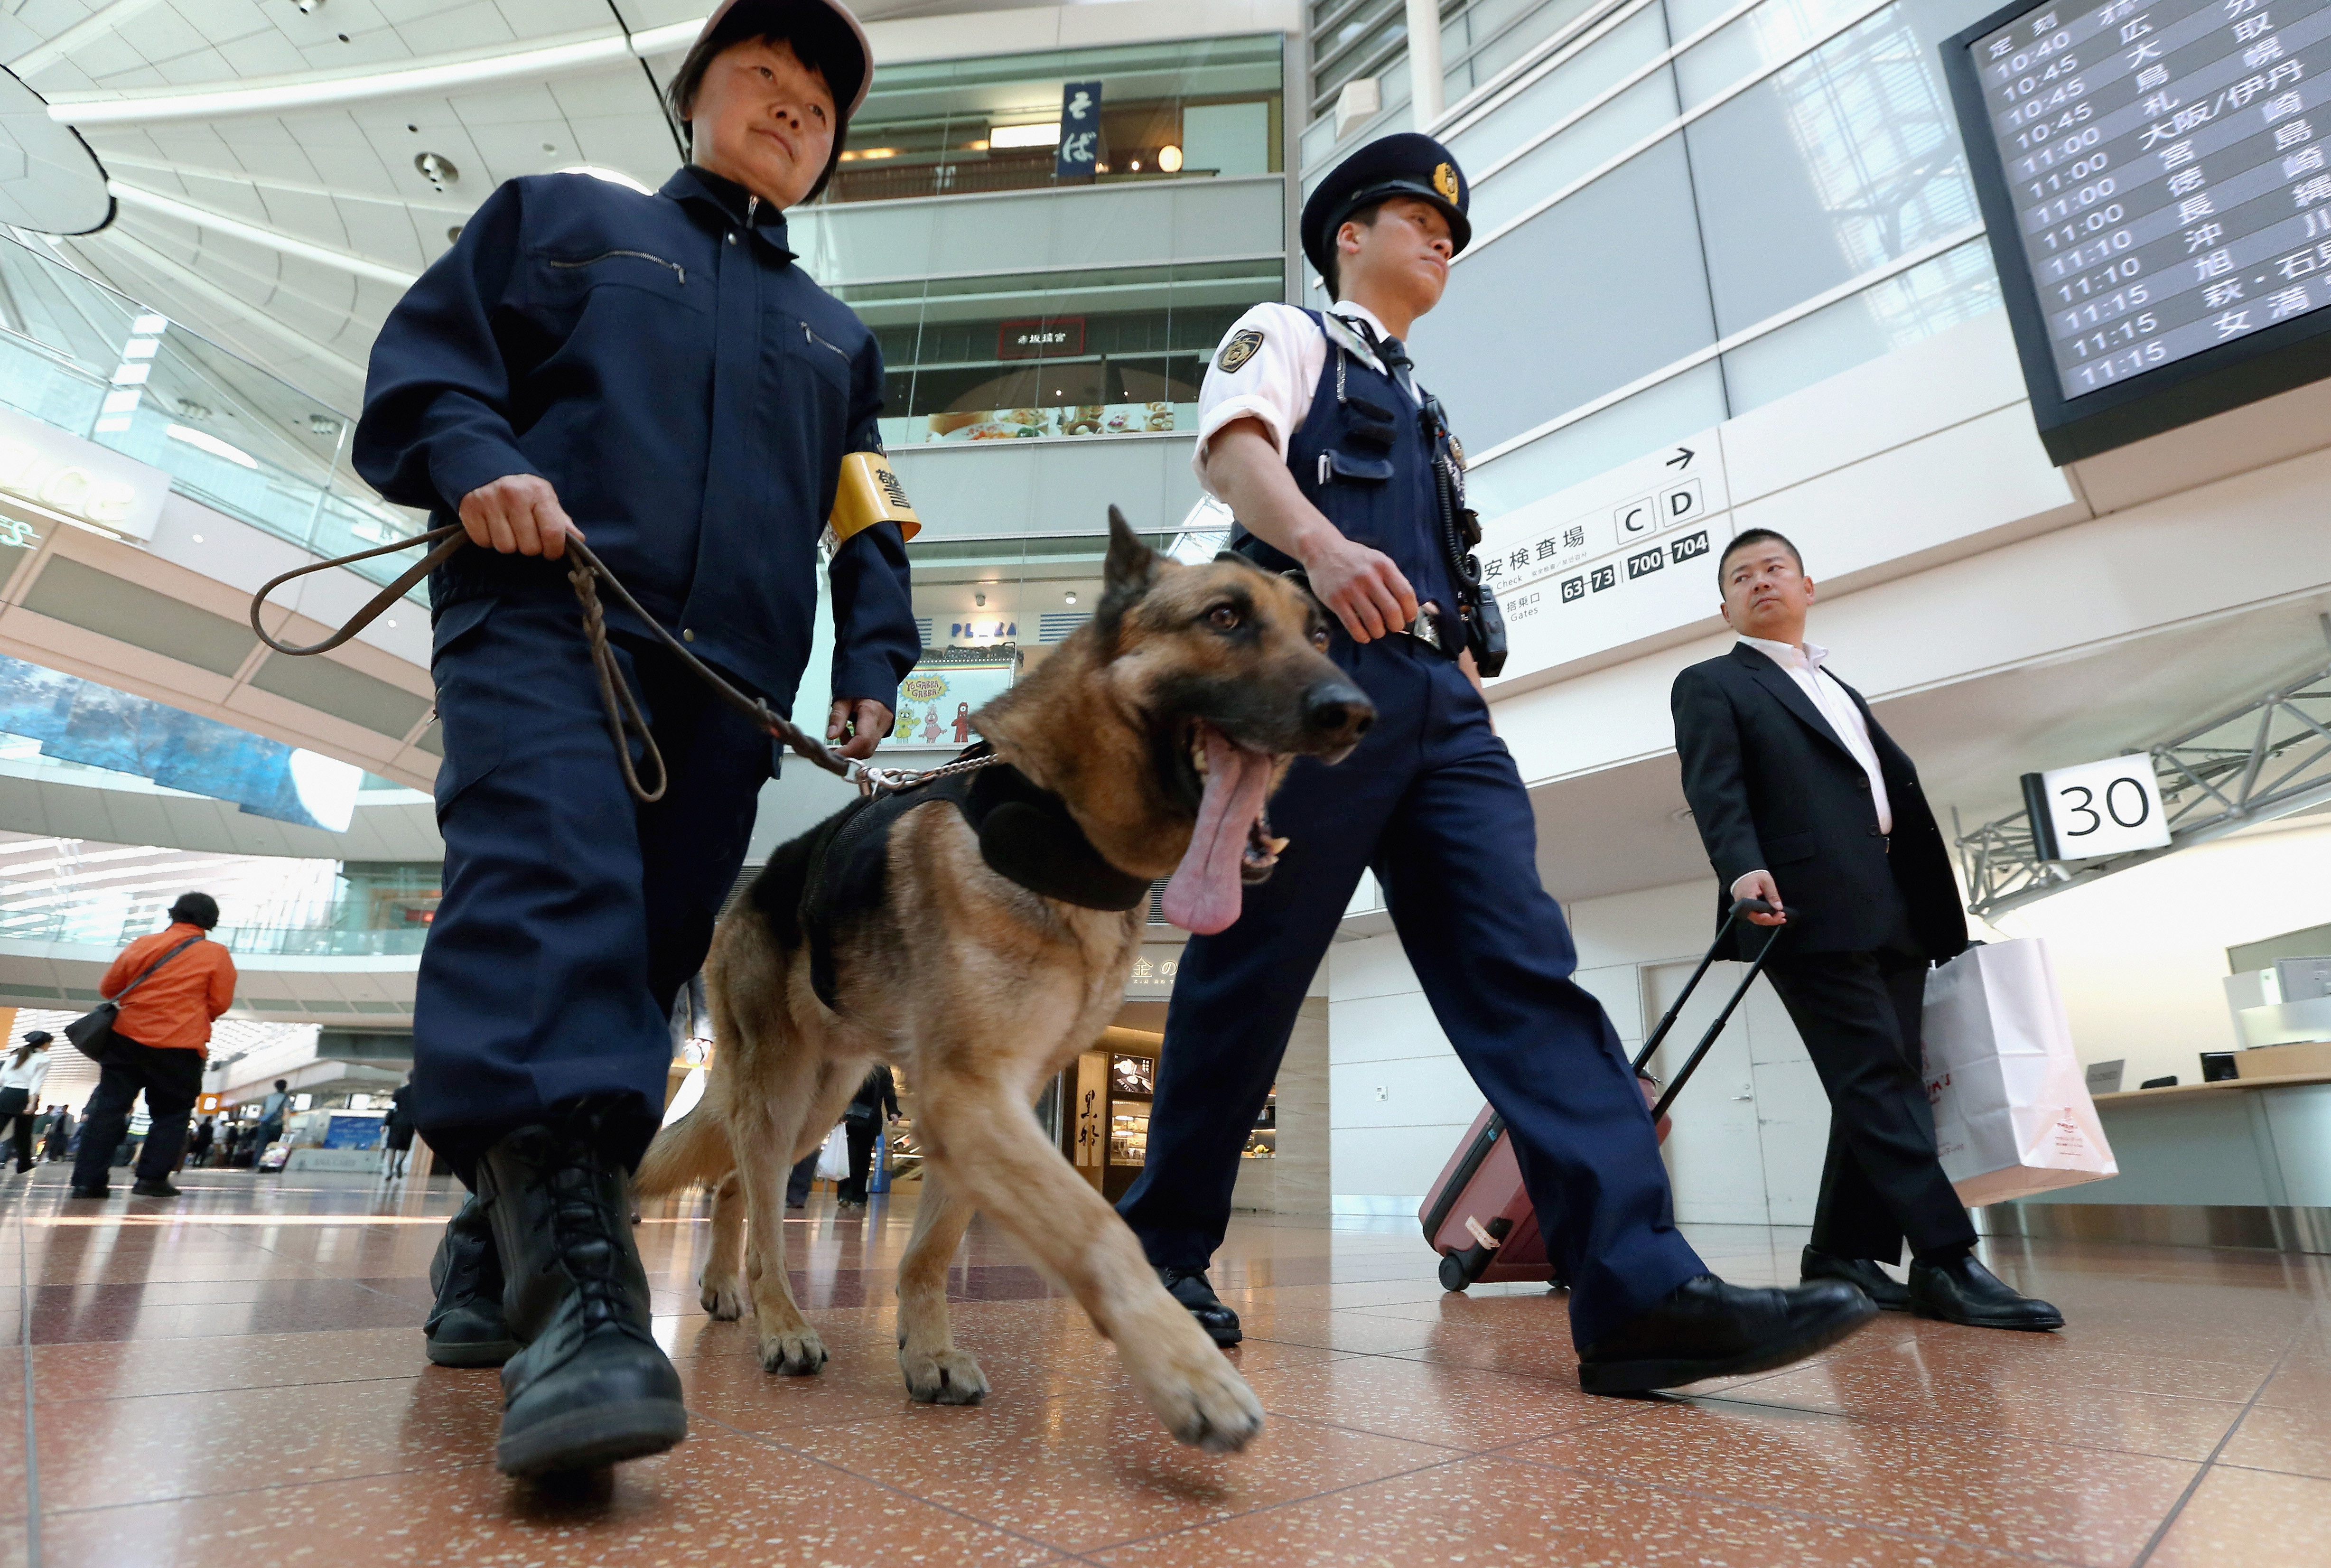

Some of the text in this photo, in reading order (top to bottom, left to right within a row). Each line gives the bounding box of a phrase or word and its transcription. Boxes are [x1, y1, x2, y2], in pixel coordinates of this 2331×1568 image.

[1997, 31, 2070, 78] 10:40
[2004, 54, 2077, 101] 10:45
[2010, 77, 2085, 125] 10:45
[1063, 91, 1097, 162] そば
[2016, 102, 2093, 149] 10:45
[2023, 127, 2099, 173] 11:00
[2030, 152, 2107, 198] 11:00
[2036, 178, 2116, 223] 11:00
[2044, 203, 2124, 249] 11:00
[2052, 230, 2132, 275] 11:10
[2059, 257, 2140, 302] 11:10
[2066, 284, 2149, 329] 11:15
[2073, 311, 2158, 356] 11:15
[2081, 340, 2167, 385] 11:15
[1626, 492, 1692, 532] C D
[1484, 525, 1585, 581] 安検査場
[1563, 534, 1708, 599] 63 73 700 704
[1497, 575, 1522, 589] Check
[1507, 593, 1540, 613] 搭乗口
[952, 622, 1016, 637] PLZA
[1510, 607, 1538, 622] Gates
[2060, 777, 2150, 837] 30
[204, 1097, 217, 1110] B
